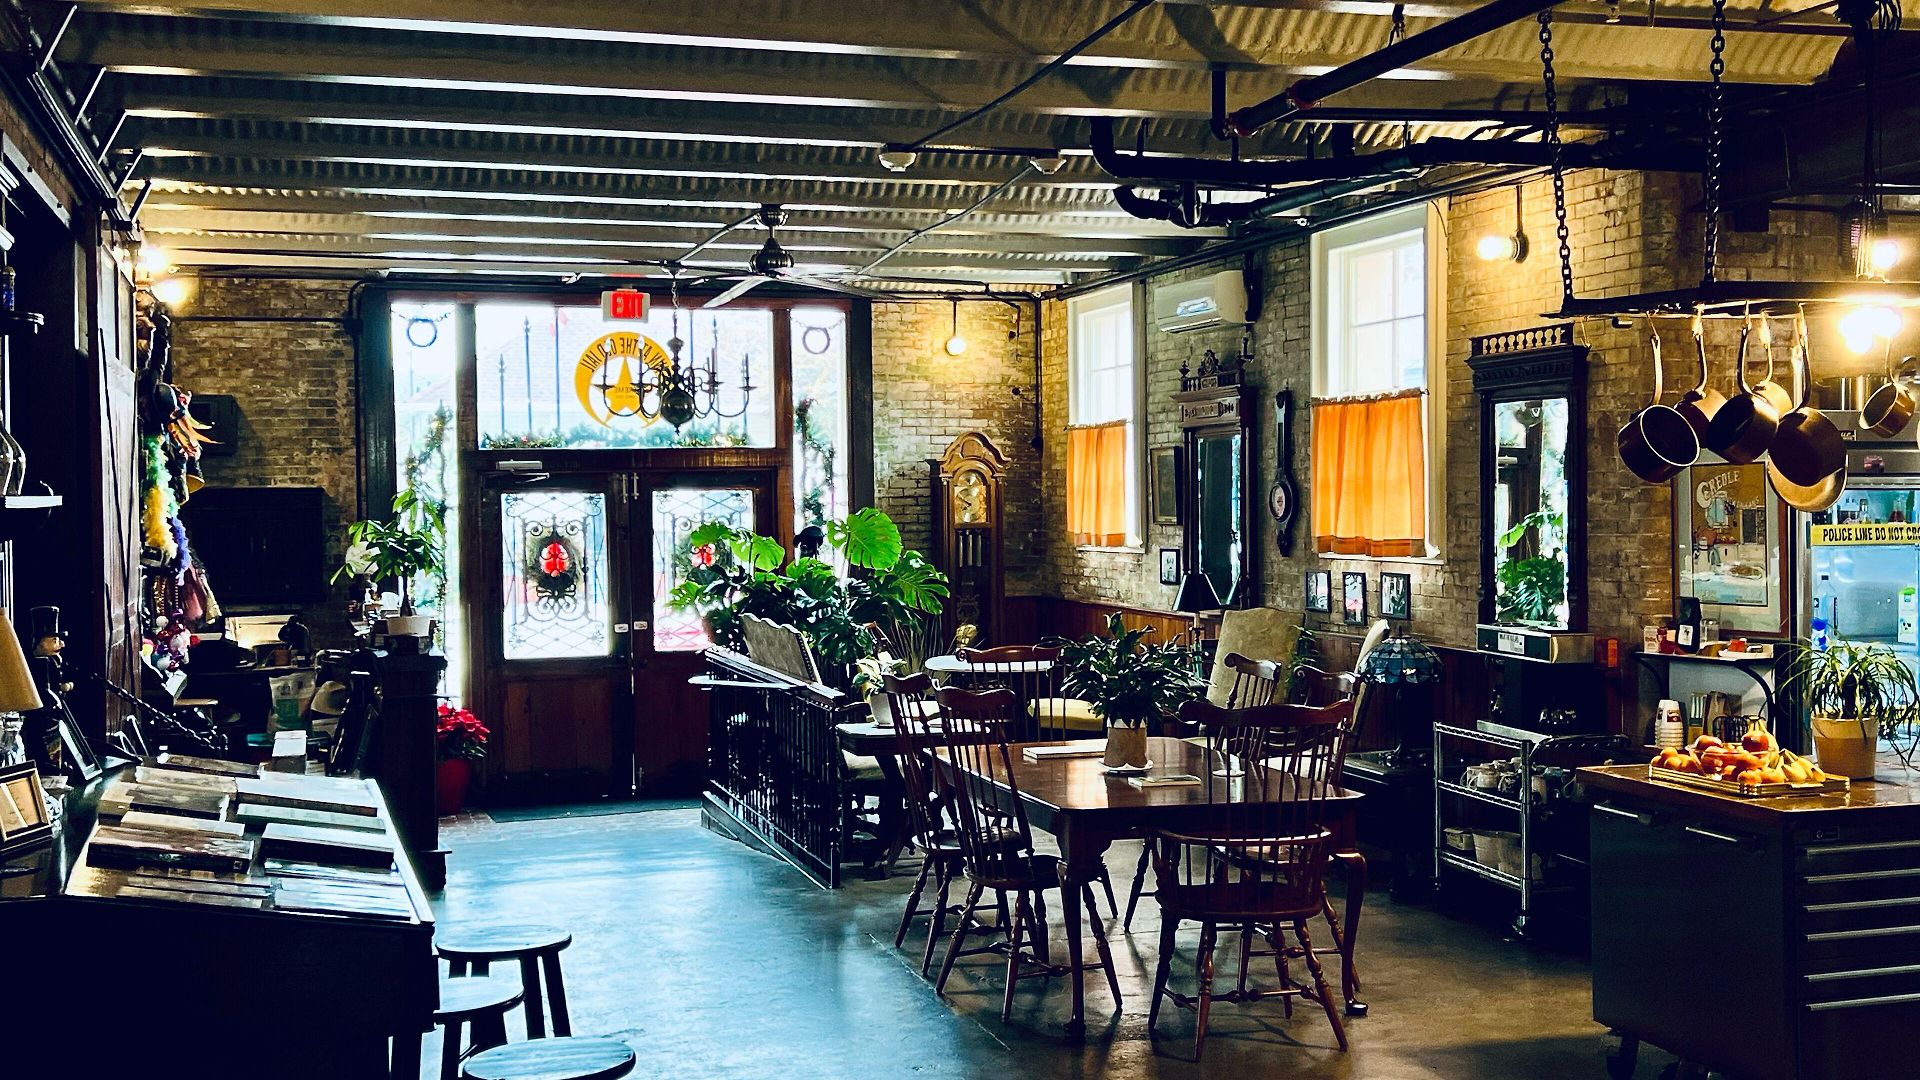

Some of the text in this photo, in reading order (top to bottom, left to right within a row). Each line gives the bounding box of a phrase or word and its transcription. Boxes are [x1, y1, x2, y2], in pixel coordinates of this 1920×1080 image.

[611, 291, 644, 319] EXIT
[1696, 470, 1740, 509] CREOLE
[1823, 527, 1852, 542] POLICE
[1855, 527, 1872, 541] LINE
[1875, 527, 1887, 541] DO
[1888, 526, 1905, 541] NOT
